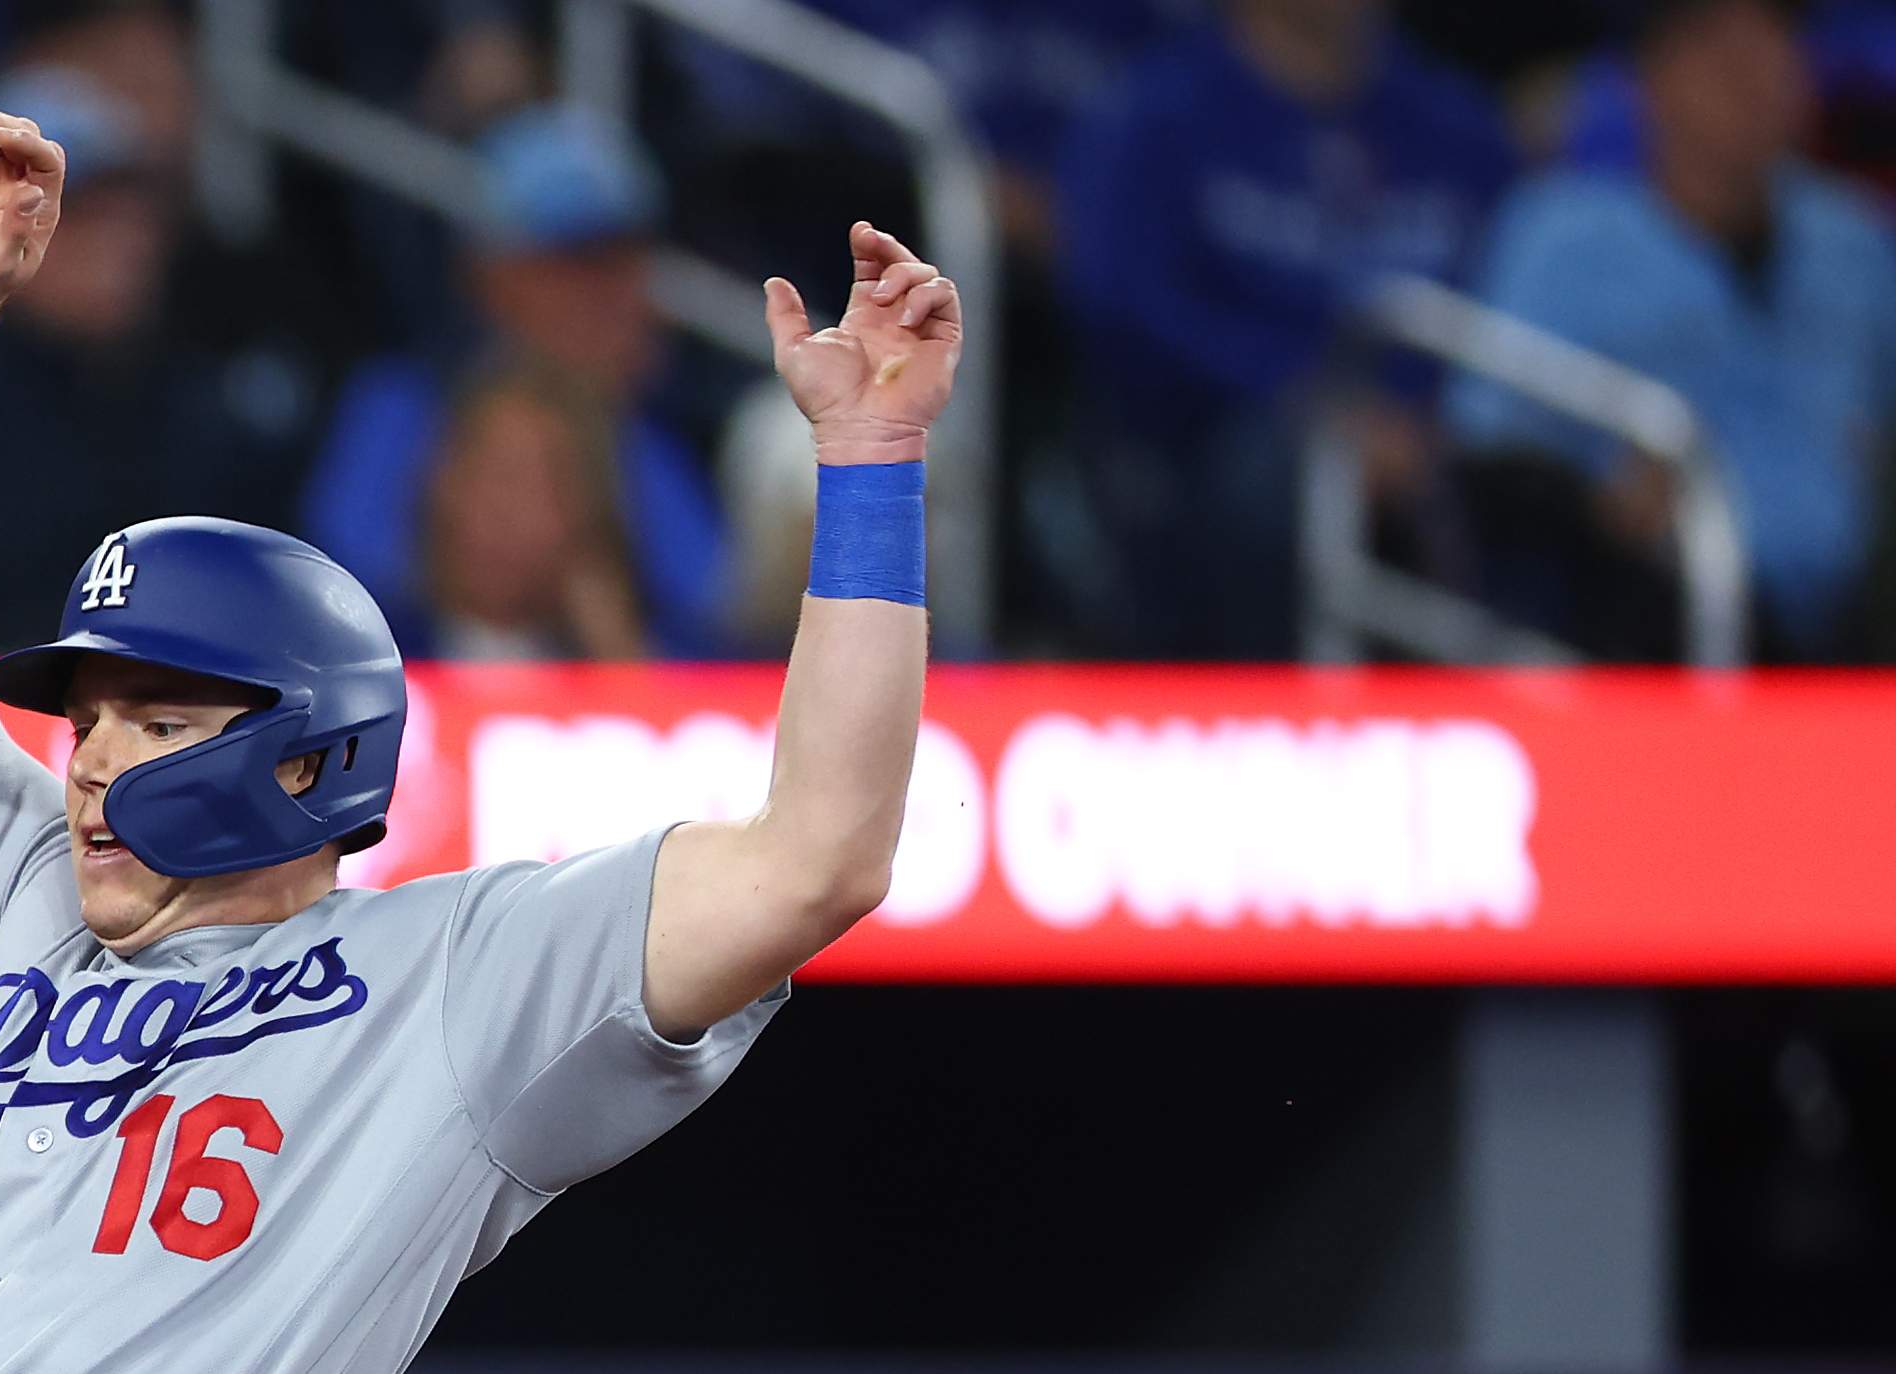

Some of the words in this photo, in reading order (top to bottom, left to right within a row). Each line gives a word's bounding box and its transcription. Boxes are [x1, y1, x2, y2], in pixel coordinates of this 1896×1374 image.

[81, 532, 135, 611] LA
[1000, 712, 1528, 927] OWNER
[92, 1093, 284, 1261] 16
